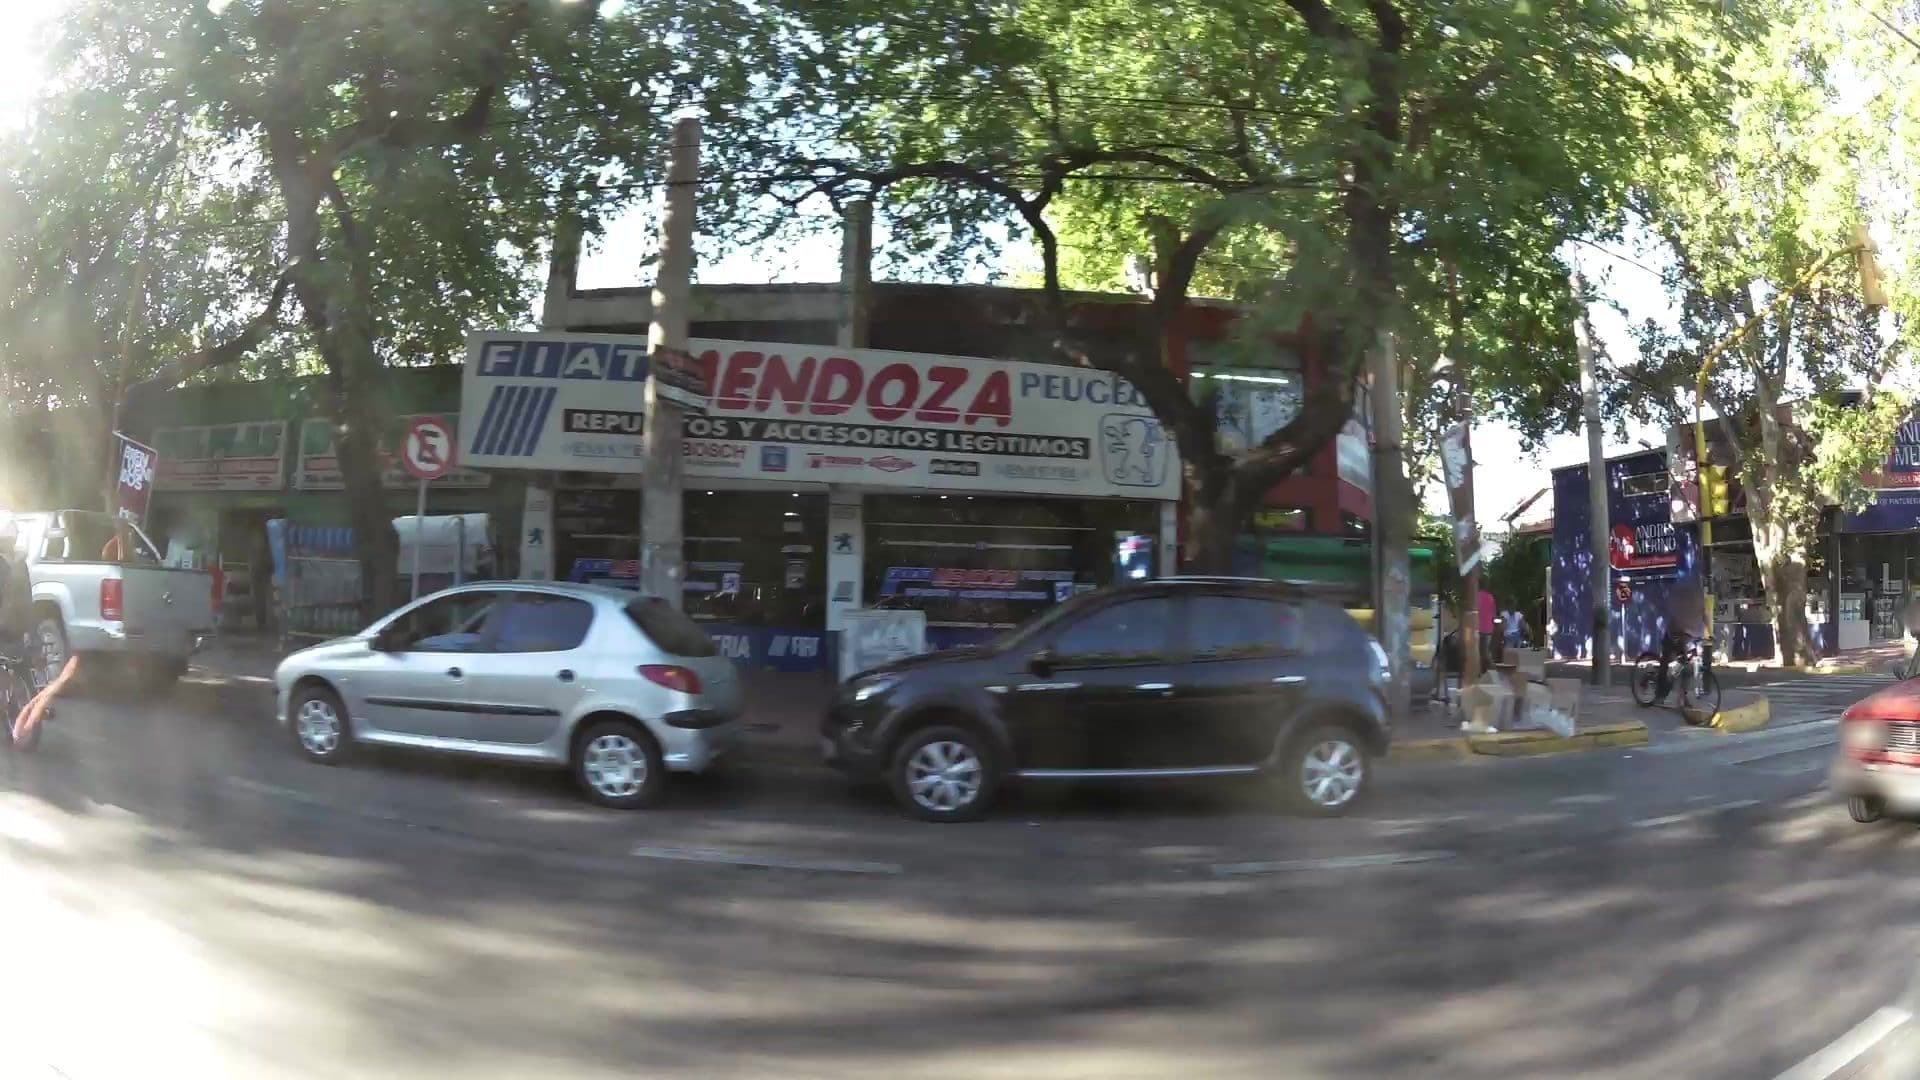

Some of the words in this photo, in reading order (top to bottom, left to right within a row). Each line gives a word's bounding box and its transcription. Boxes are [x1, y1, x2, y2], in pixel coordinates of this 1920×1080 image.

[481, 342, 648, 379] FIAT
[572, 412, 727, 437] REPUOS
[740, 420, 757, 438] Y
[763, 423, 938, 448] ACCESORIOS
[945, 431, 1085, 458] LEGITIMOS
